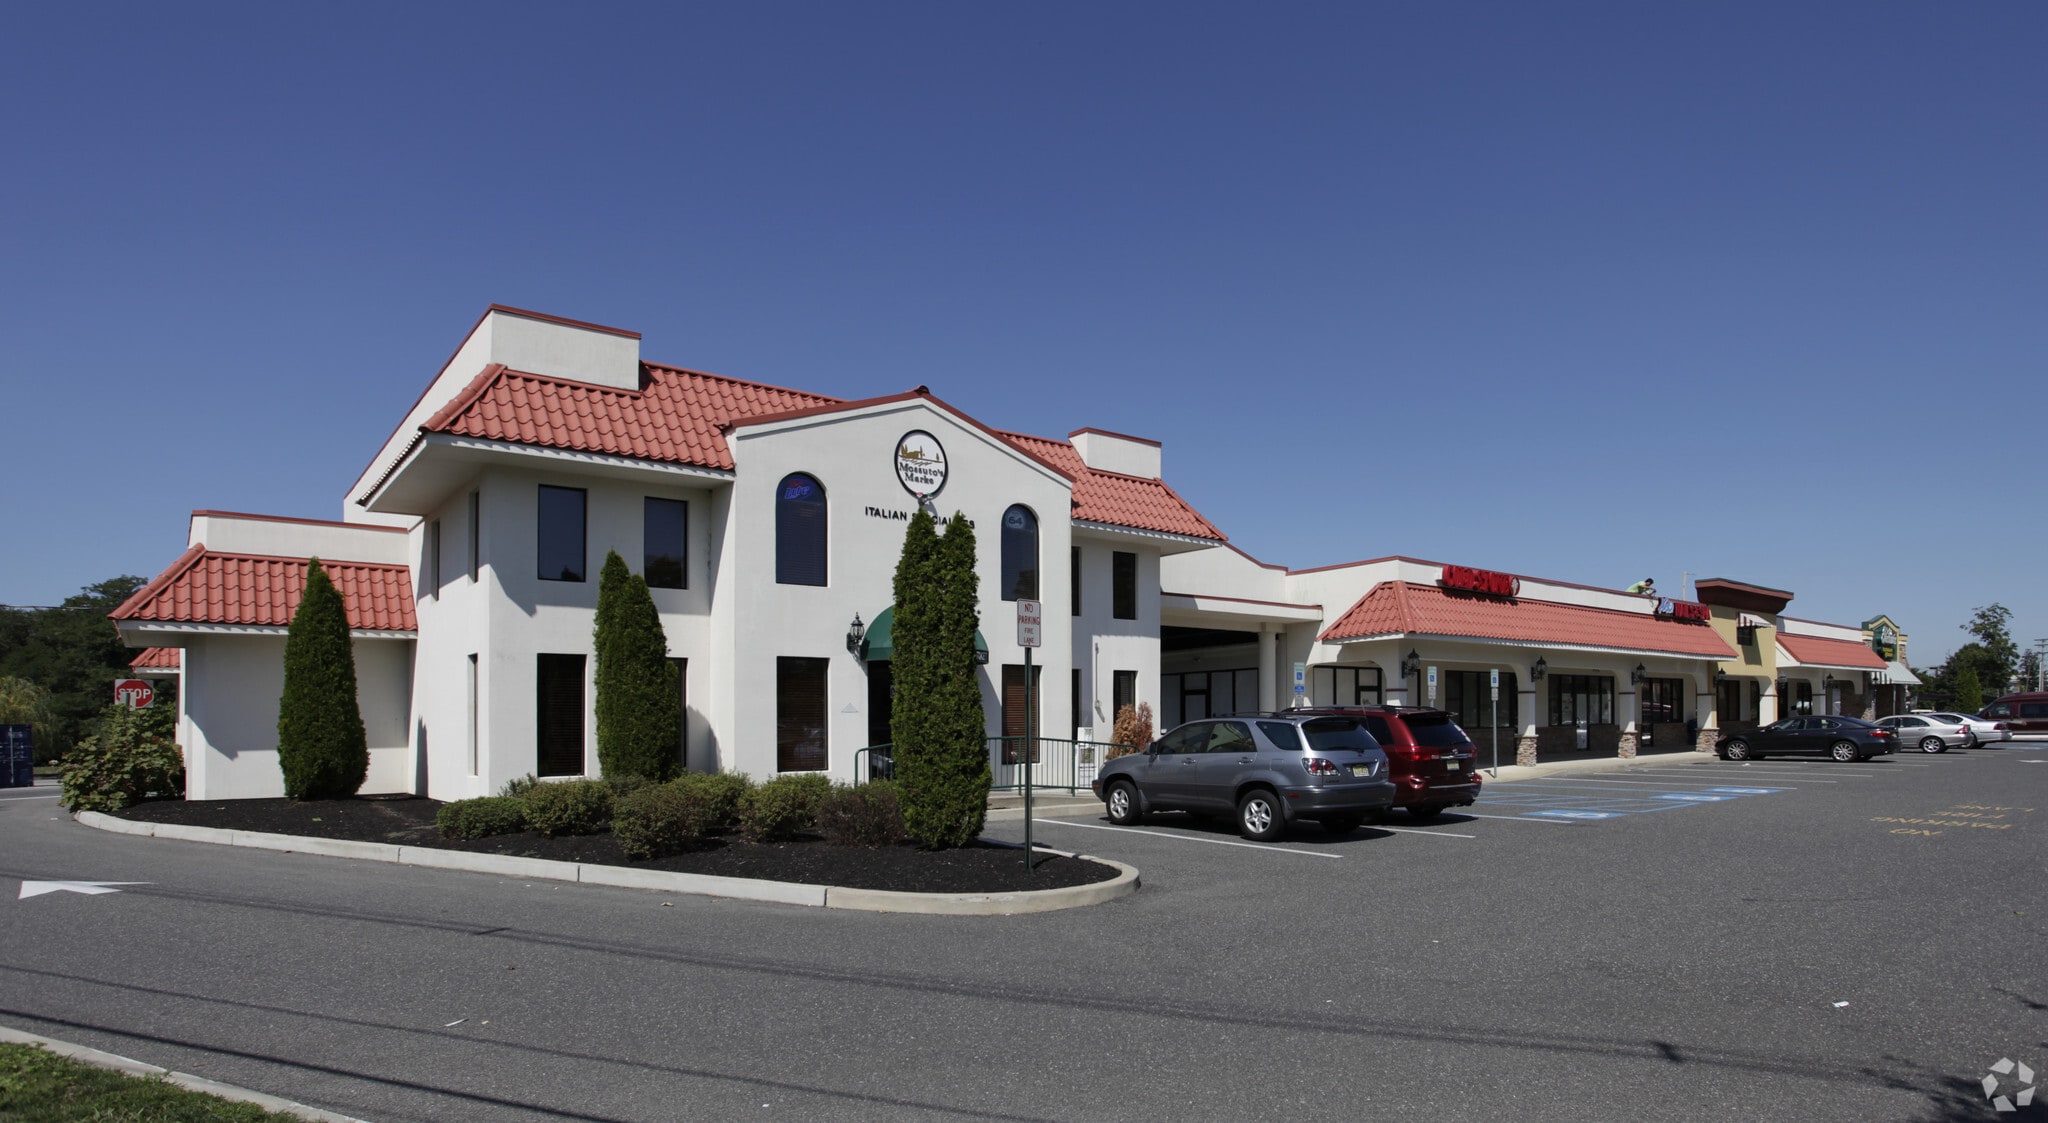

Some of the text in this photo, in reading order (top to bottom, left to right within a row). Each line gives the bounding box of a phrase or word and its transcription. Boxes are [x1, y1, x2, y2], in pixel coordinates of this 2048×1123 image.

[865, 506, 907, 521] ITALIAN
[1024, 603, 1034, 613] NO
[1018, 615, 1040, 626] PARKING
[1024, 627, 1034, 635] FIRE
